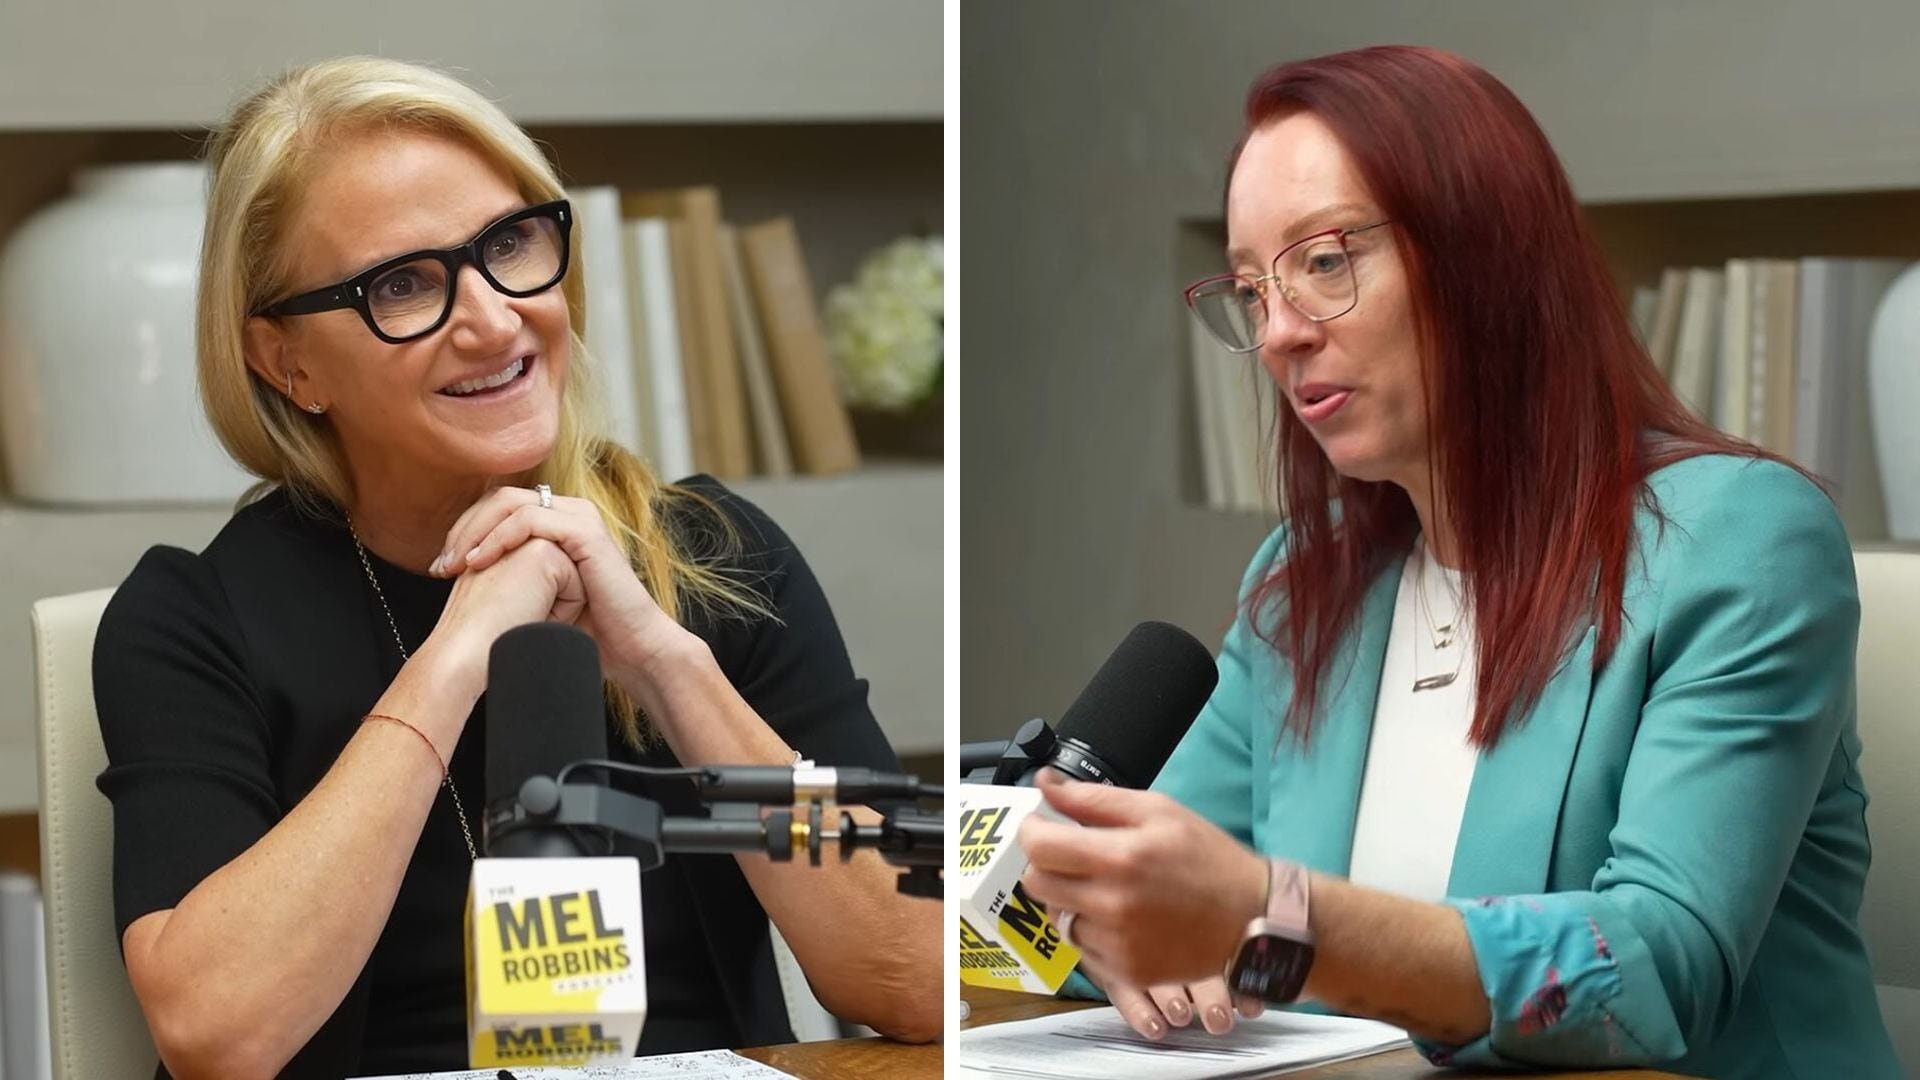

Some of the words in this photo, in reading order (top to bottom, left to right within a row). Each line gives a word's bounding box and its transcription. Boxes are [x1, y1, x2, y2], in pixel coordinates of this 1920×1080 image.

[960, 806, 1011, 847] EL
[960, 847, 995, 867] INS
[988, 889, 1006, 914] THE
[494, 889, 624, 954] MEL
[1034, 922, 1060, 961] RO
[501, 944, 631, 984] ROBBINS
